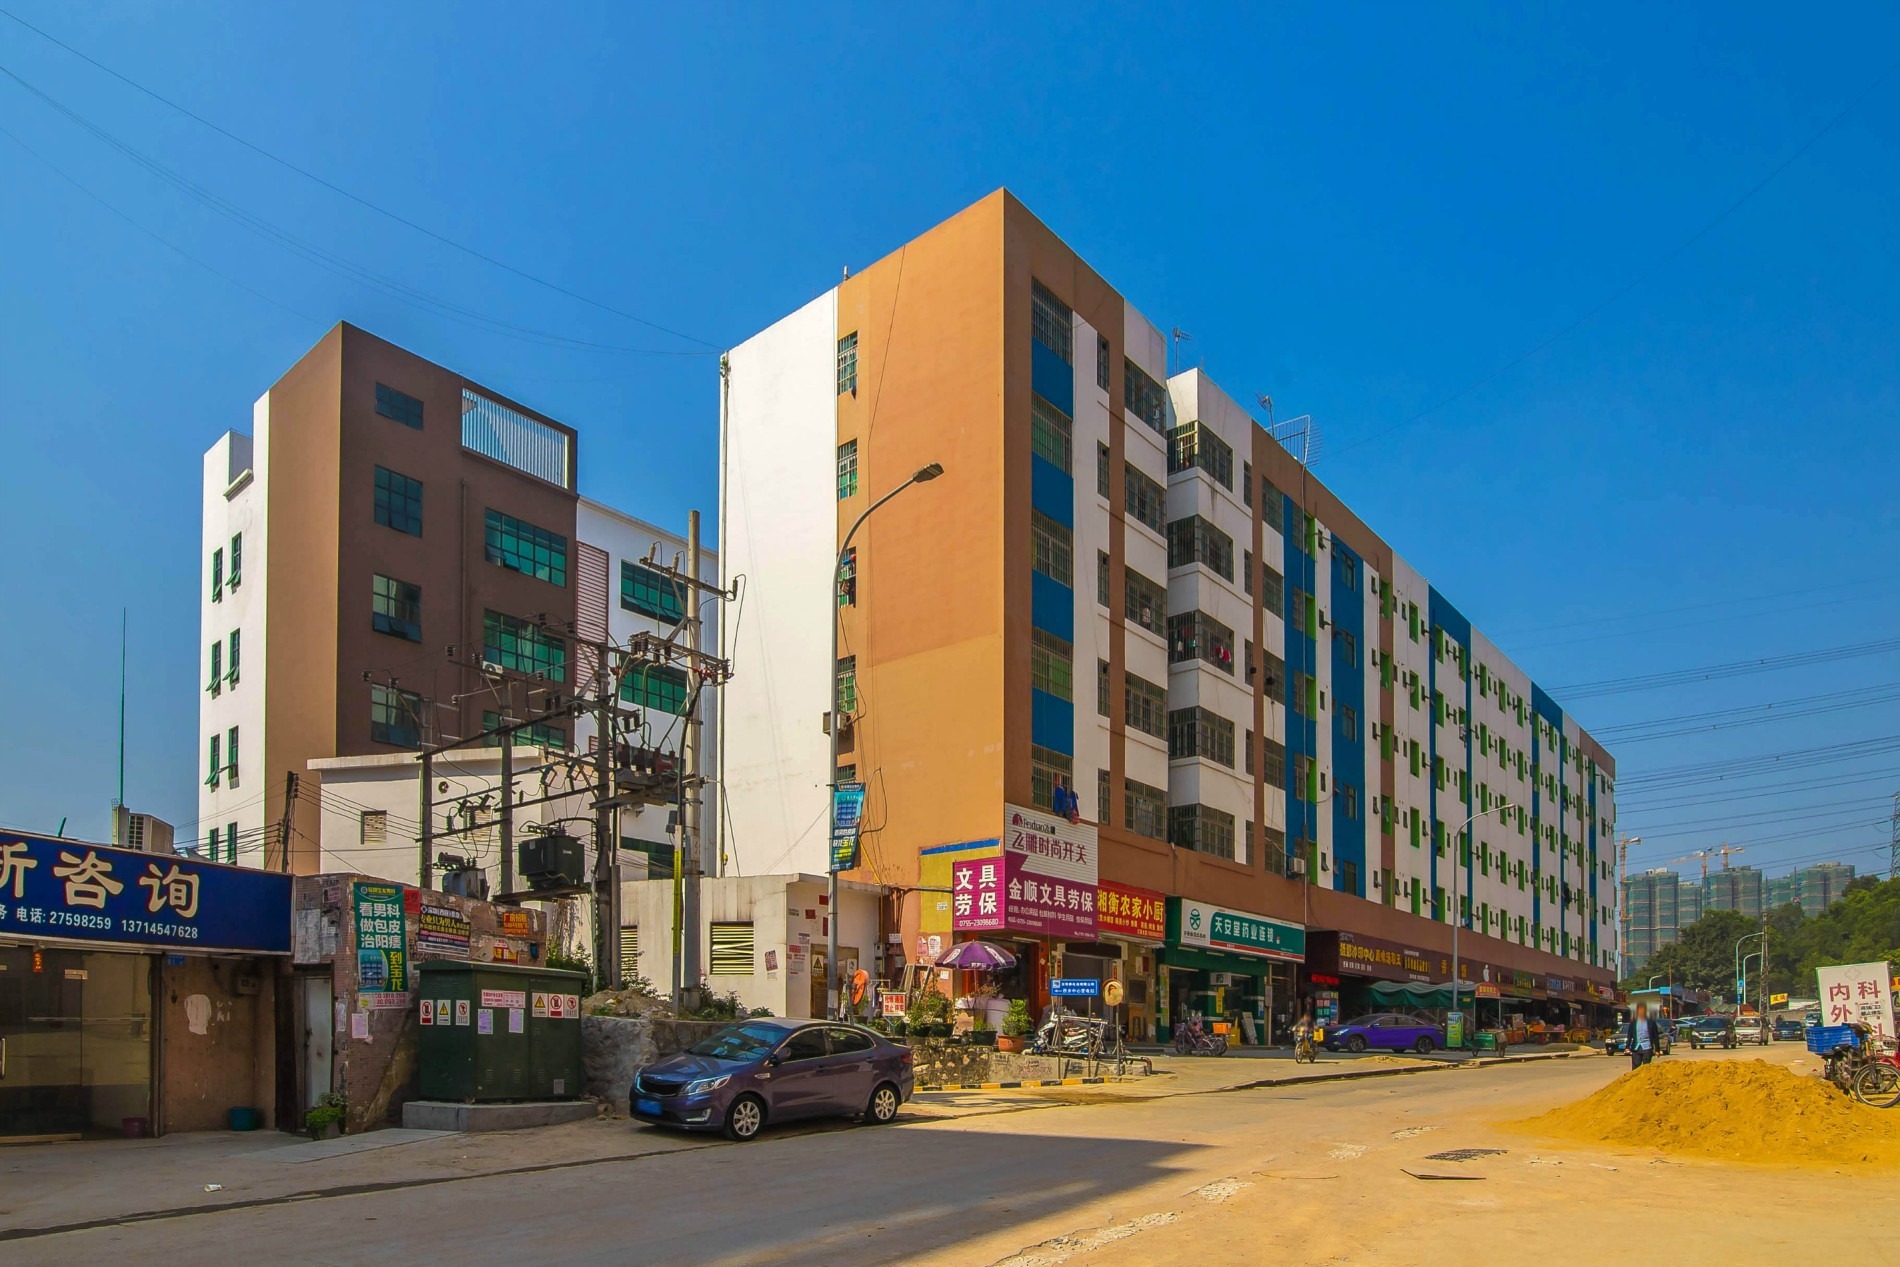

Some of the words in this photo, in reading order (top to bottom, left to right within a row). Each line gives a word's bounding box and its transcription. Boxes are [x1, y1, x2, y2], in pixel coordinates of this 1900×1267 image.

[1012, 830, 1087, 865] 飞雕时尚开关
[955, 865, 998, 891] 文具
[955, 892, 998, 917] 劳保
[1009, 877, 1094, 913] 金顺文具劳保
[1097, 888, 1164, 923] 湘衡农家小厨
[359, 901, 401, 918] 看男科
[50, 911, 112, 931] 27598259
[122, 919, 198, 939] 13714547628
[360, 919, 401, 934] 做包皮
[361, 933, 402, 950] 治阳痿
[389, 951, 403, 992] 到宝龙
[1829, 979, 1882, 1003] 内科
